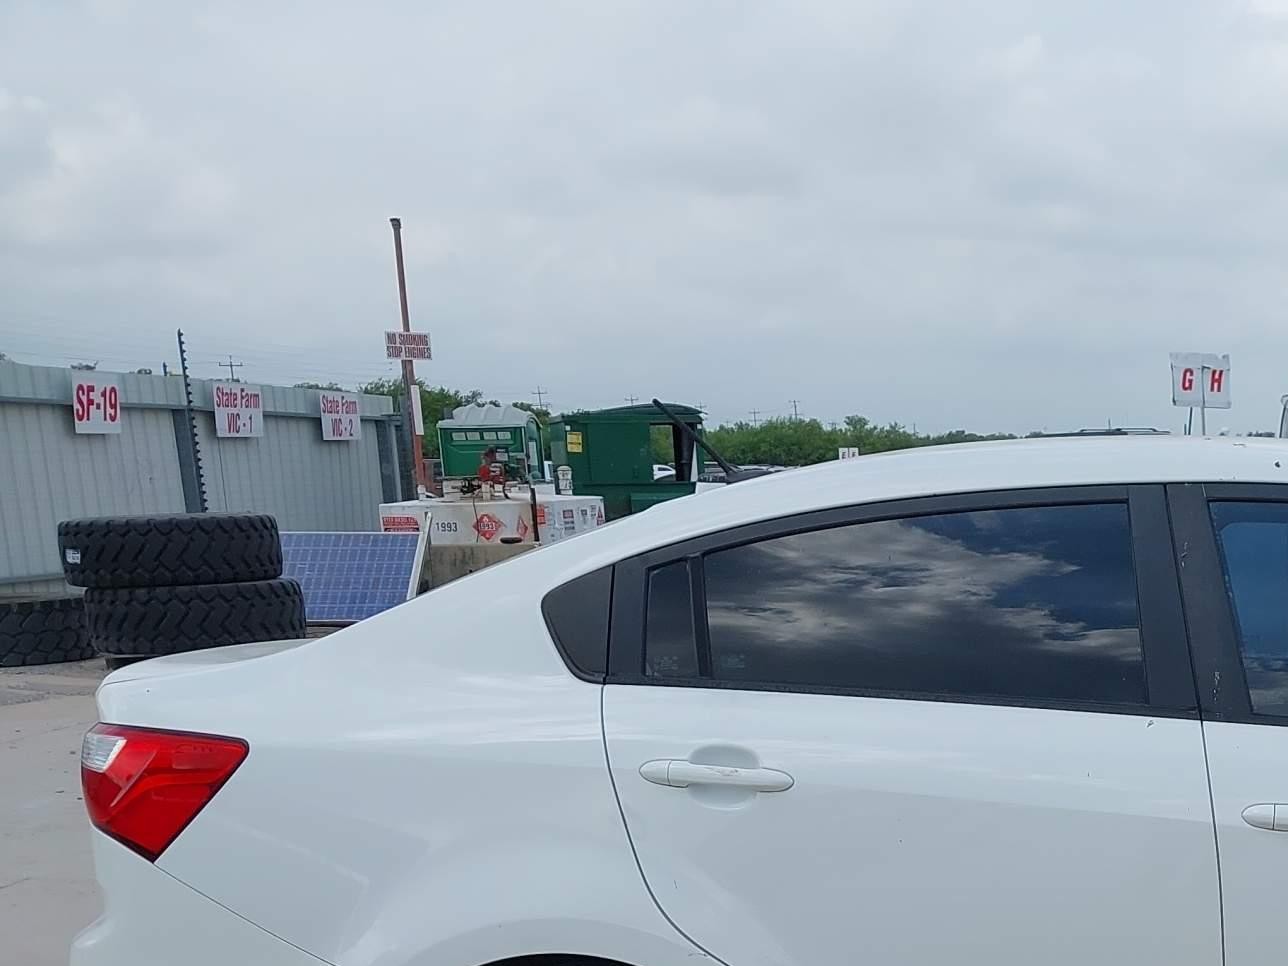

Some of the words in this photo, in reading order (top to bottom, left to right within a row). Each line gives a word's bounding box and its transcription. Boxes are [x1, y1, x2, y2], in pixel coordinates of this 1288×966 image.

[387, 332, 396, 345] NO
[398, 333, 429, 347] SMOKING
[386, 345, 402, 358] STOP
[404, 346, 432, 359] ENGINES
[1182, 367, 1194, 391] G
[1210, 369, 1224, 393] H
[75, 383, 118, 422] SF-19
[216, 386, 237, 409] State
[240, 387, 260, 409] Farm
[321, 394, 339, 414] State
[341, 395, 358, 415] Farm
[227, 412, 240, 434] VIC
[248, 413, 253, 433] 1
[331, 417, 343, 438] VIC
[348, 418, 354, 437] 2
[435, 521, 458, 533] 1993
